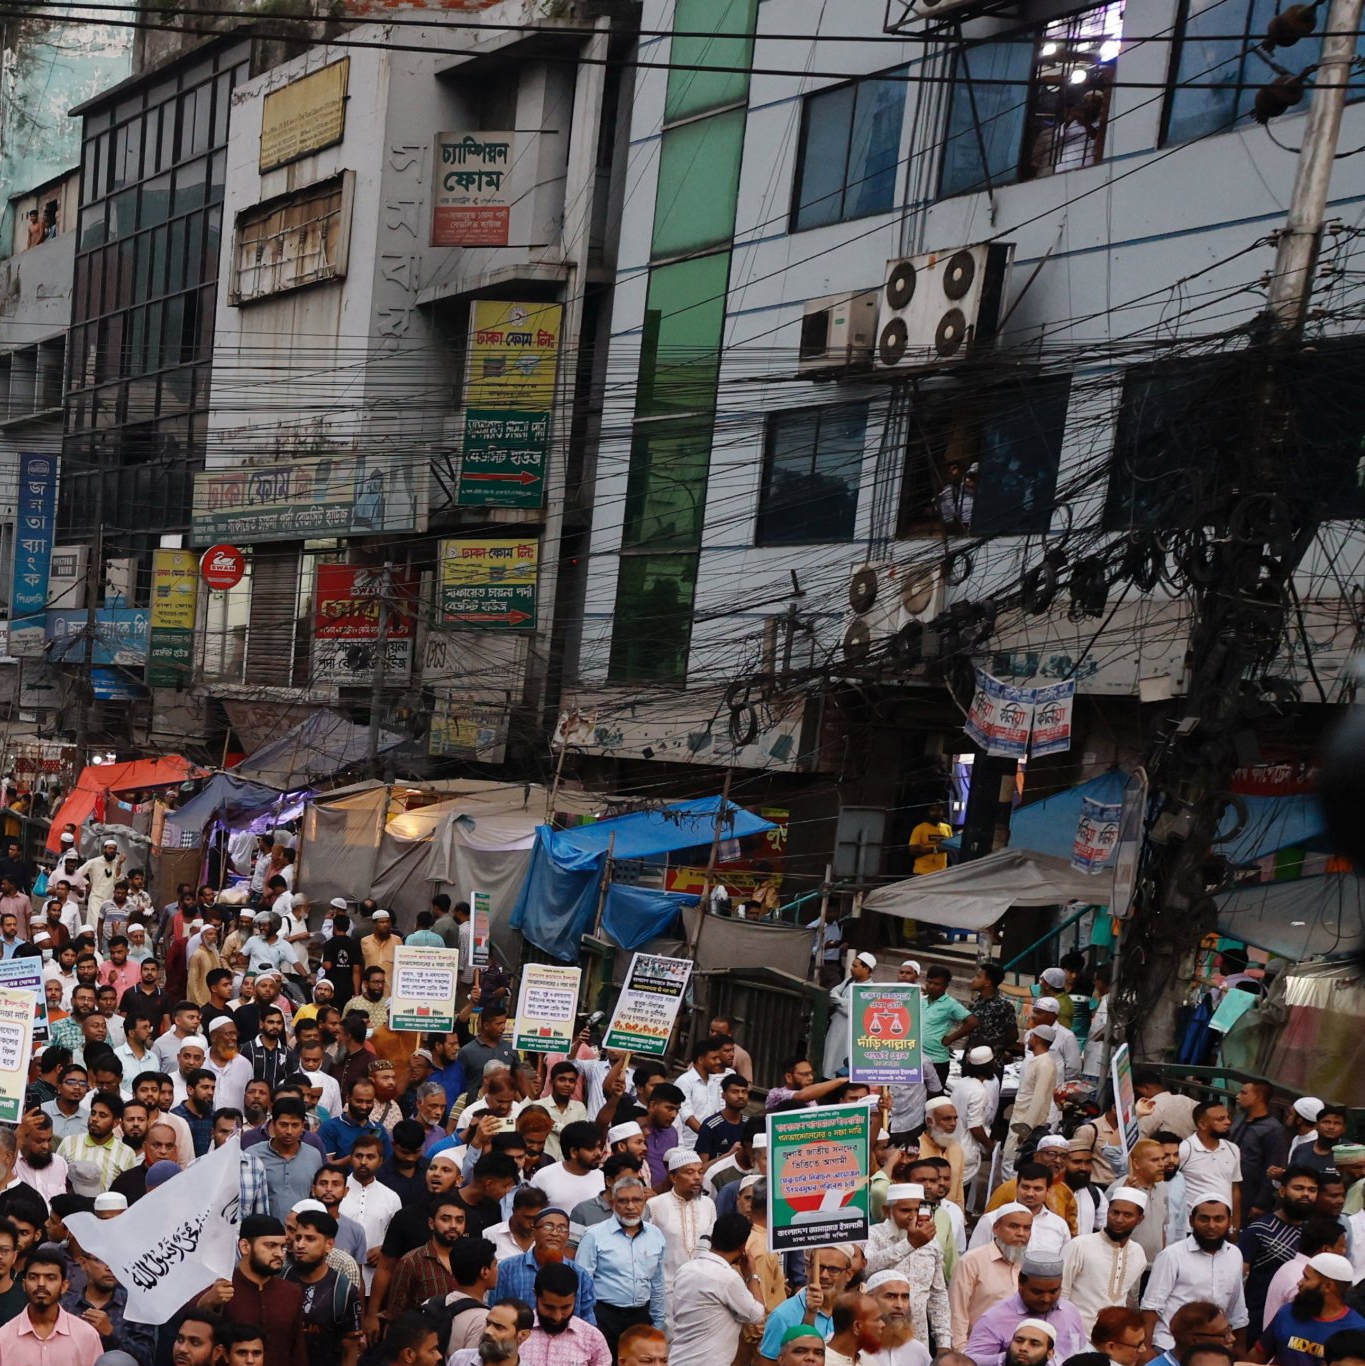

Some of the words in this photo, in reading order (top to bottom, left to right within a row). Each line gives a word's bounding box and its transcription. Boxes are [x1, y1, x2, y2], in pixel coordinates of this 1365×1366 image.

[441, 136, 510, 165] চ্যাম্পিয়ন
[444, 170, 504, 192] ফোম
[506, 332, 533, 347] ফোম
[25, 481, 47, 529] জনতা
[21, 539, 47, 587] ব্যাংক
